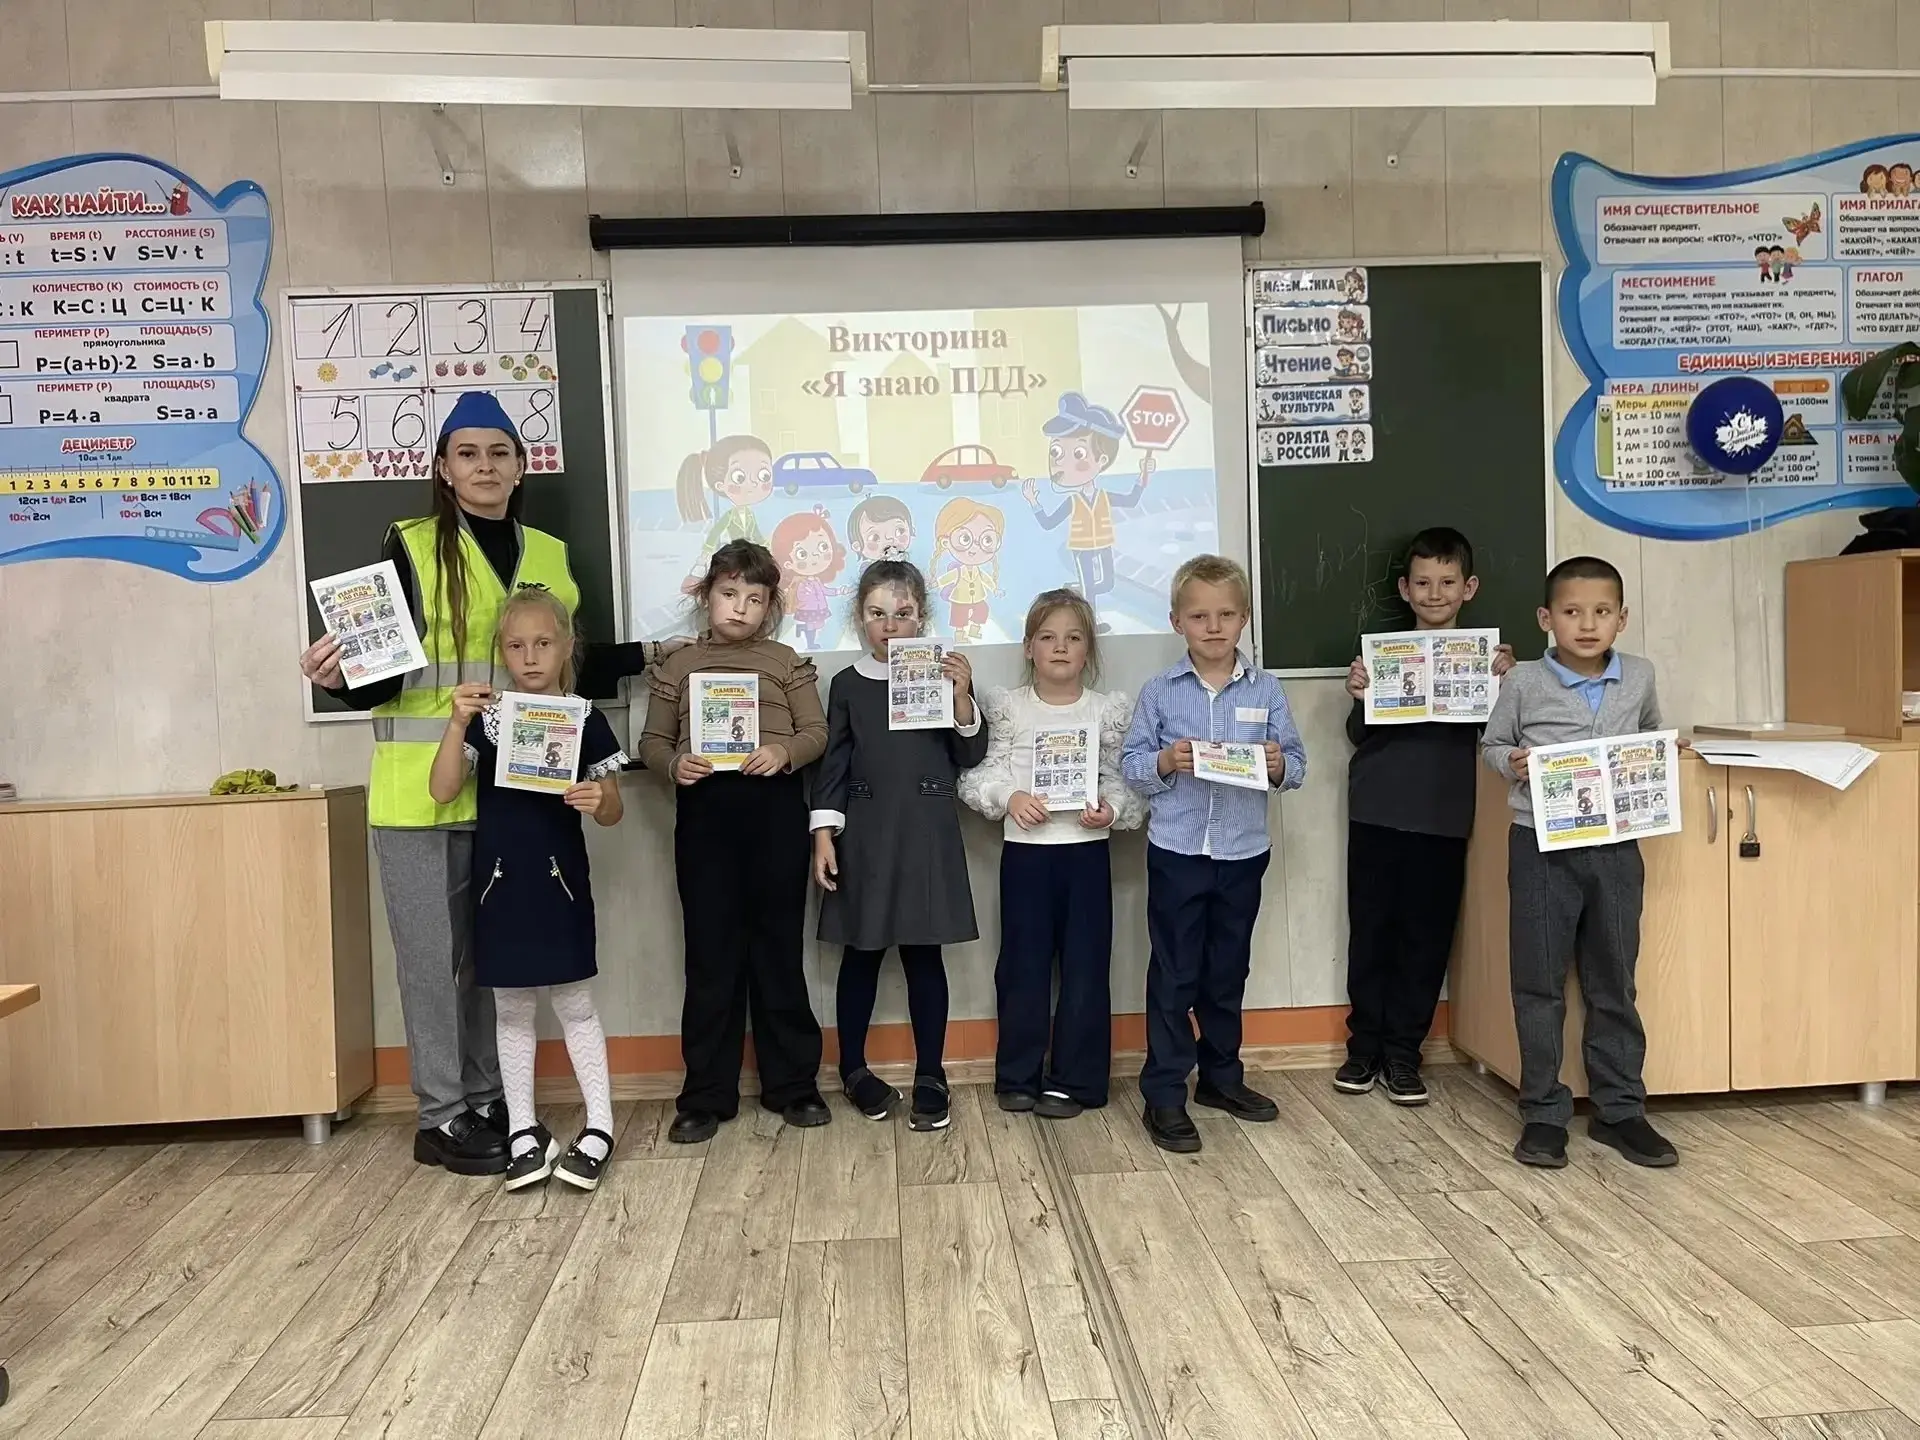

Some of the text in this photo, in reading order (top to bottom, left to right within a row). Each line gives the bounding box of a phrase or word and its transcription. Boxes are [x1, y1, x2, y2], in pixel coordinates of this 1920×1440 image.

[12, 187, 165, 215] КАК НАЙТИ...
[1840, 200, 1866, 210] ИМЯ
[1604, 203, 1760, 217] ИМЯ СУЩЕСТВИТЕЛЬНОЕ
[125, 228, 215, 238] РАССТОЯНИЕ (S)
[1604, 224, 1700, 232] Обозначает предмет.
[50, 230, 102, 241] ВРЕМЯ (t)
[1622, 276, 1716, 288] МЕСТОИМЕНИЕ
[1857, 272, 1903, 282] ГЛАГОЛ
[33, 282, 104, 293] КОЛИЧЕСТВО
[134, 282, 199, 290] СТОИМОСТЬ
[386, 302, 420, 356] 2
[453, 300, 487, 353] 3
[520, 297, 549, 351] 4
[1263, 315, 1331, 333] Письмо
[35, 329, 90, 338] ПЕРИМЕТР
[323, 303, 353, 358] 1
[83, 338, 165, 348] прямоугольника
[828, 326, 1008, 357] Викторина
[1265, 355, 1331, 373] Чтение
[1678, 351, 1862, 372] ЕДИНИЦЫ ИЗМЕРЕНИЯ
[37, 383, 93, 392] ПЕРИМЕТР
[801, 365, 1047, 399] «Я знаю ПДД»
[1611, 382, 1699, 394] МЕРА ДЛИНЫ
[105, 395, 150, 403] квадрата
[1272, 390, 1342, 401] ФИЗИЧЕСКАЯ
[1280, 402, 1334, 414] КУЛЬТУРА
[1616, 400, 1687, 410] Меры длины
[392, 394, 424, 447] 6
[520, 389, 553, 442] 8
[1132, 410, 1175, 427] STOP
[1650, 411, 1661, 419] 10
[328, 395, 360, 450] 5
[1624, 427, 1640, 437] дм
[1652, 426, 1663, 434] 10
[1276, 431, 1329, 445] ОРЛЯТА
[1848, 435, 1880, 445] МЕРА
[61, 438, 136, 453] ДЕЦИМЕТР
[1625, 442, 1640, 452] дм
[1653, 440, 1669, 449] 100
[1277, 445, 1330, 460] РОССИИ
[1646, 456, 1657, 464] 10
[1660, 456, 1676, 465] дм
[1647, 470, 1663, 478] 100
[10, 475, 211, 490] 1 2 3 4 5 6 7 8 9 10 11 12
[69, 495, 86, 503] 2см
[141, 493, 158, 501] 8см
[169, 493, 191, 501] 18см
[9, 513, 31, 521] 10см
[120, 510, 141, 518] 10см
[528, 711, 566, 719] ПАМЯТКА
[1552, 756, 1587, 767] ПАМЯТКА
